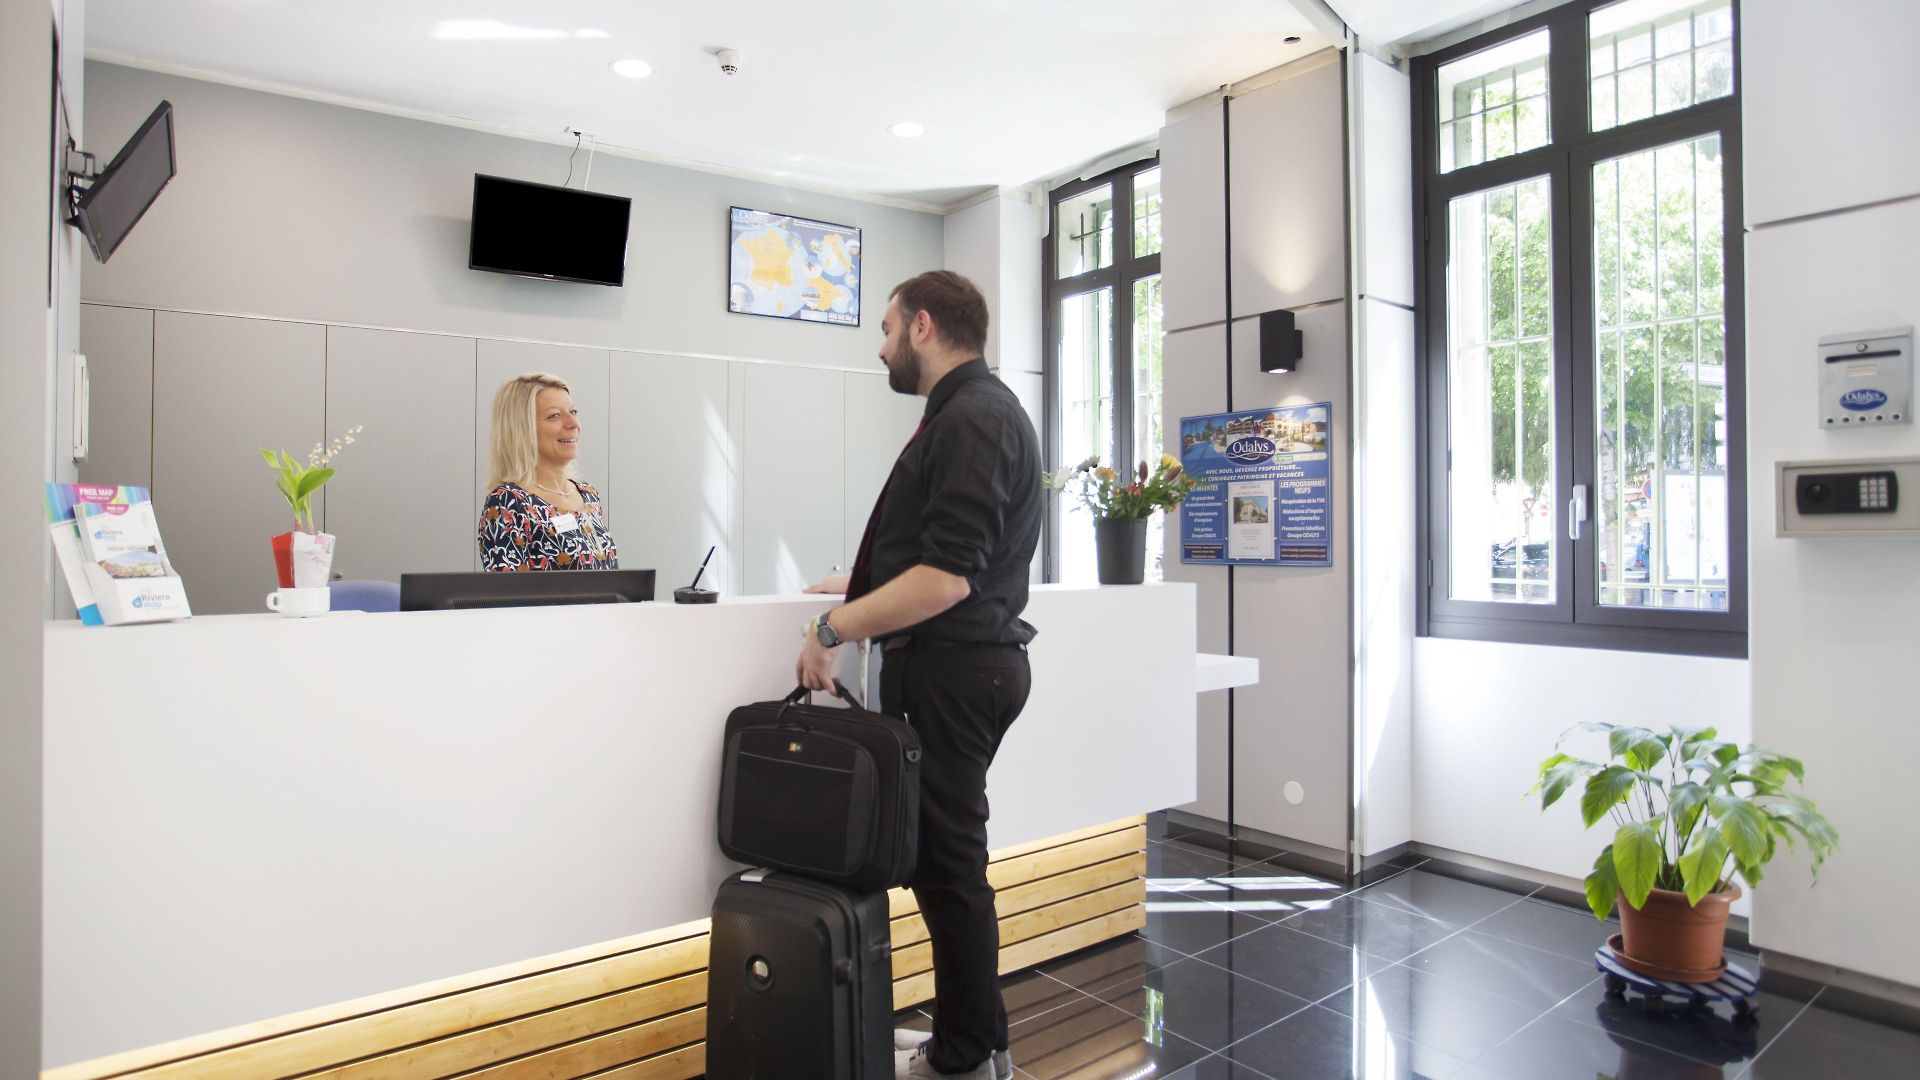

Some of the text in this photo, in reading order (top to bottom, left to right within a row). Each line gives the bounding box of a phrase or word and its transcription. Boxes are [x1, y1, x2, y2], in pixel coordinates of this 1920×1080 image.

[1232, 440, 1269, 454] Odalys
[1289, 479, 1326, 488] PROGRAMMES
[79, 488, 114, 497] FREE MAP
[141, 593, 171, 602] Riviera
